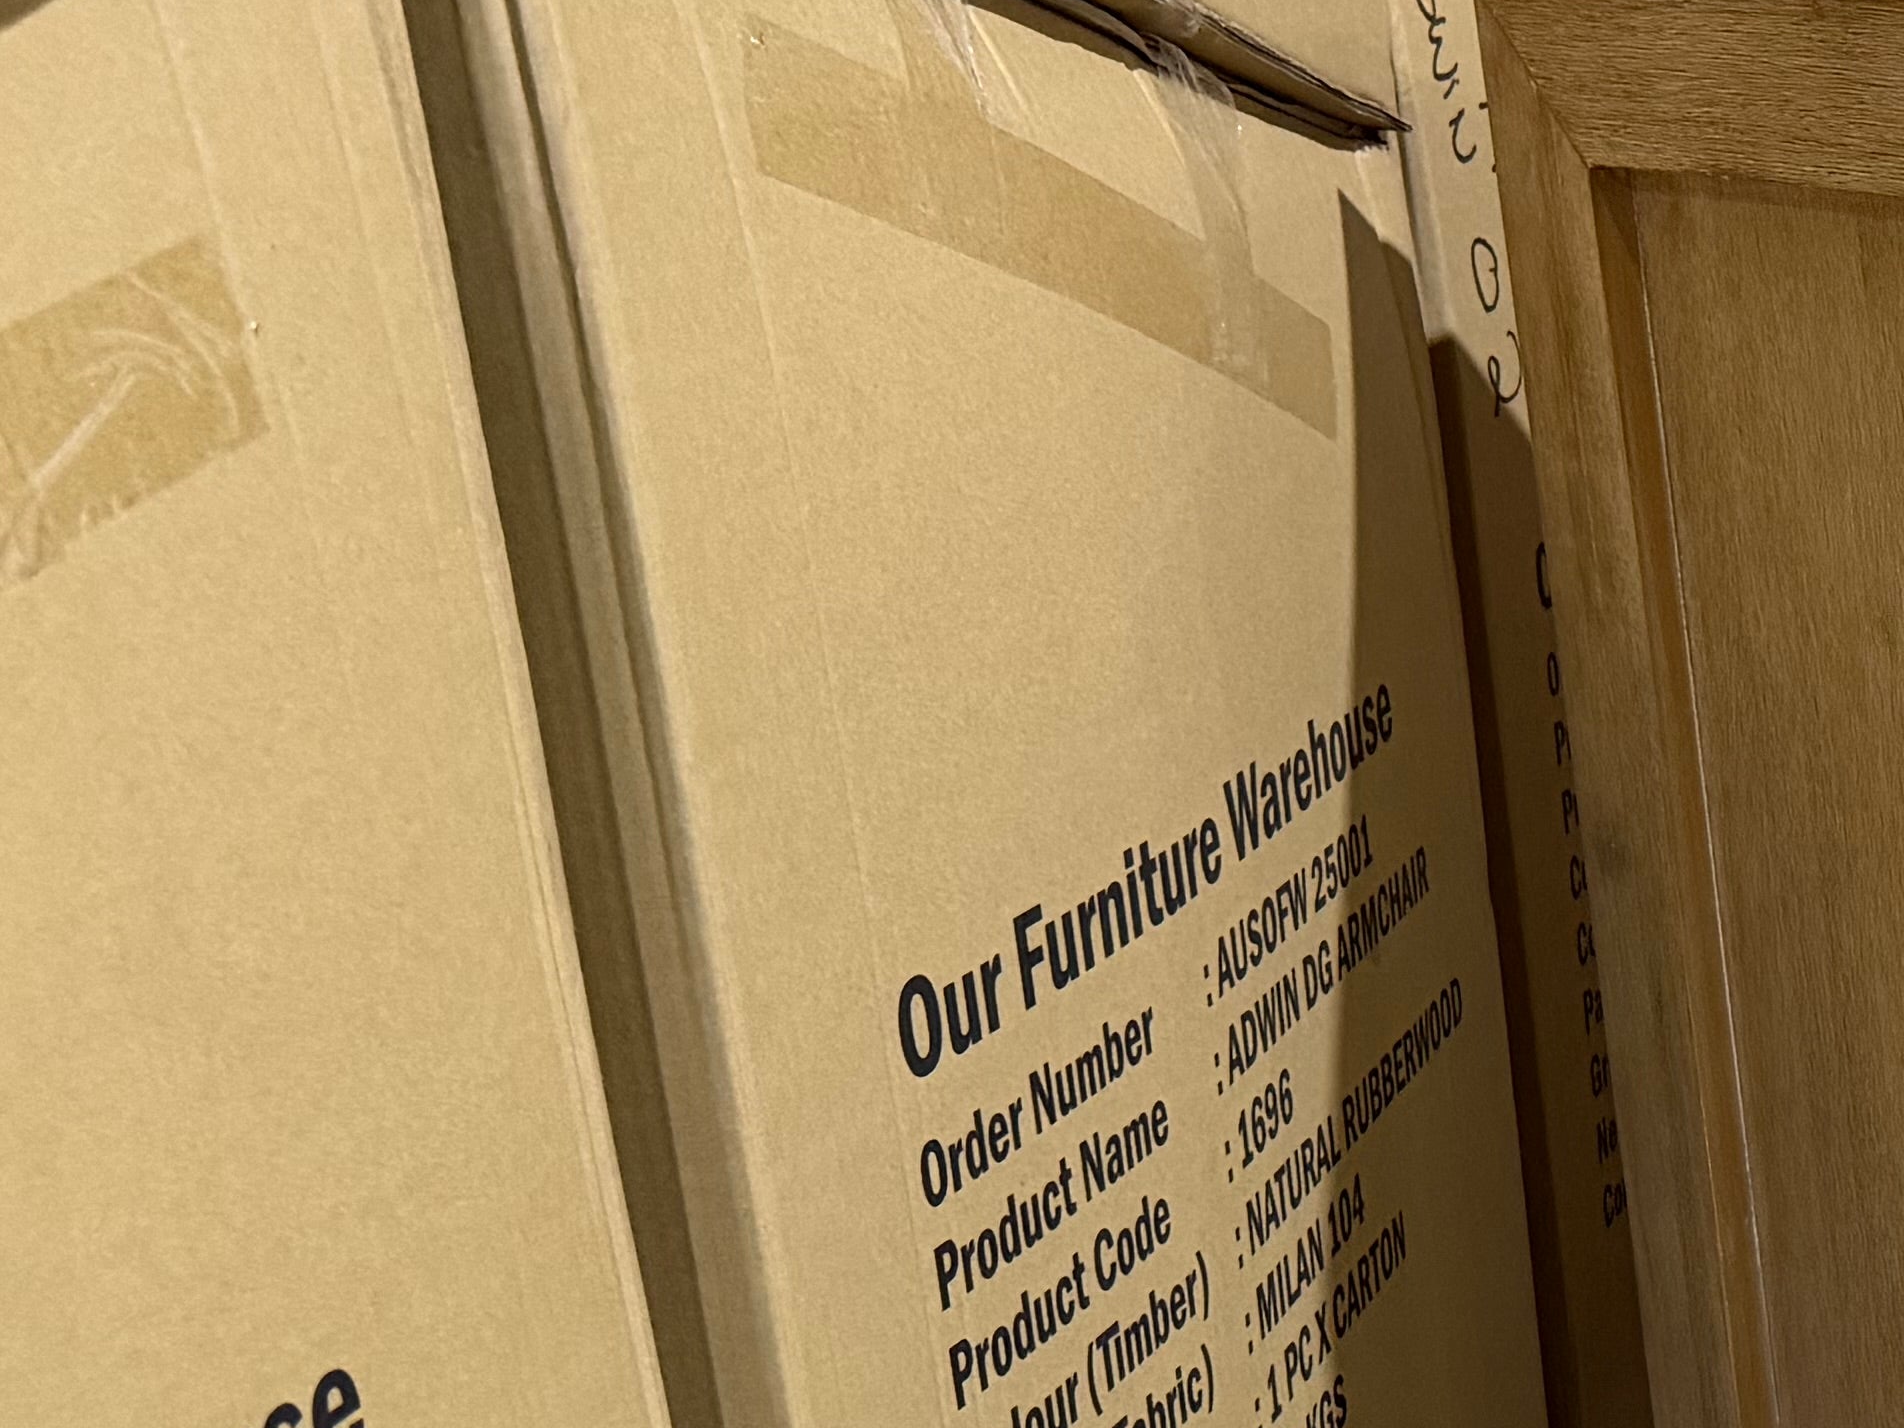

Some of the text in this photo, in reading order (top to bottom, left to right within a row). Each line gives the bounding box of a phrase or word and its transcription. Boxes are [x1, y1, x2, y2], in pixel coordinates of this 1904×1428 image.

[897, 682, 1393, 1078] Our Furniture Warehouse
[919, 814, 1374, 1208] Order Number AUSOFW 25001
[932, 848, 1430, 1313] Product Name ADWIN DG ARMCHAIR
[948, 1067, 1294, 1411] Product Code 1696
[1086, 1249, 1210, 1417] (Timber)
[1245, 1114, 1343, 1257] NATURAL
[1339, 978, 1463, 1153] RUBBERWOOD
[1255, 1217, 1325, 1341] MILAN
[1327, 1171, 1366, 1268] 104
[1267, 1363, 1283, 1424] 1
[1283, 1324, 1313, 1403] PC
[1314, 1299, 1333, 1365] X
[1331, 1209, 1407, 1352] CARTON
